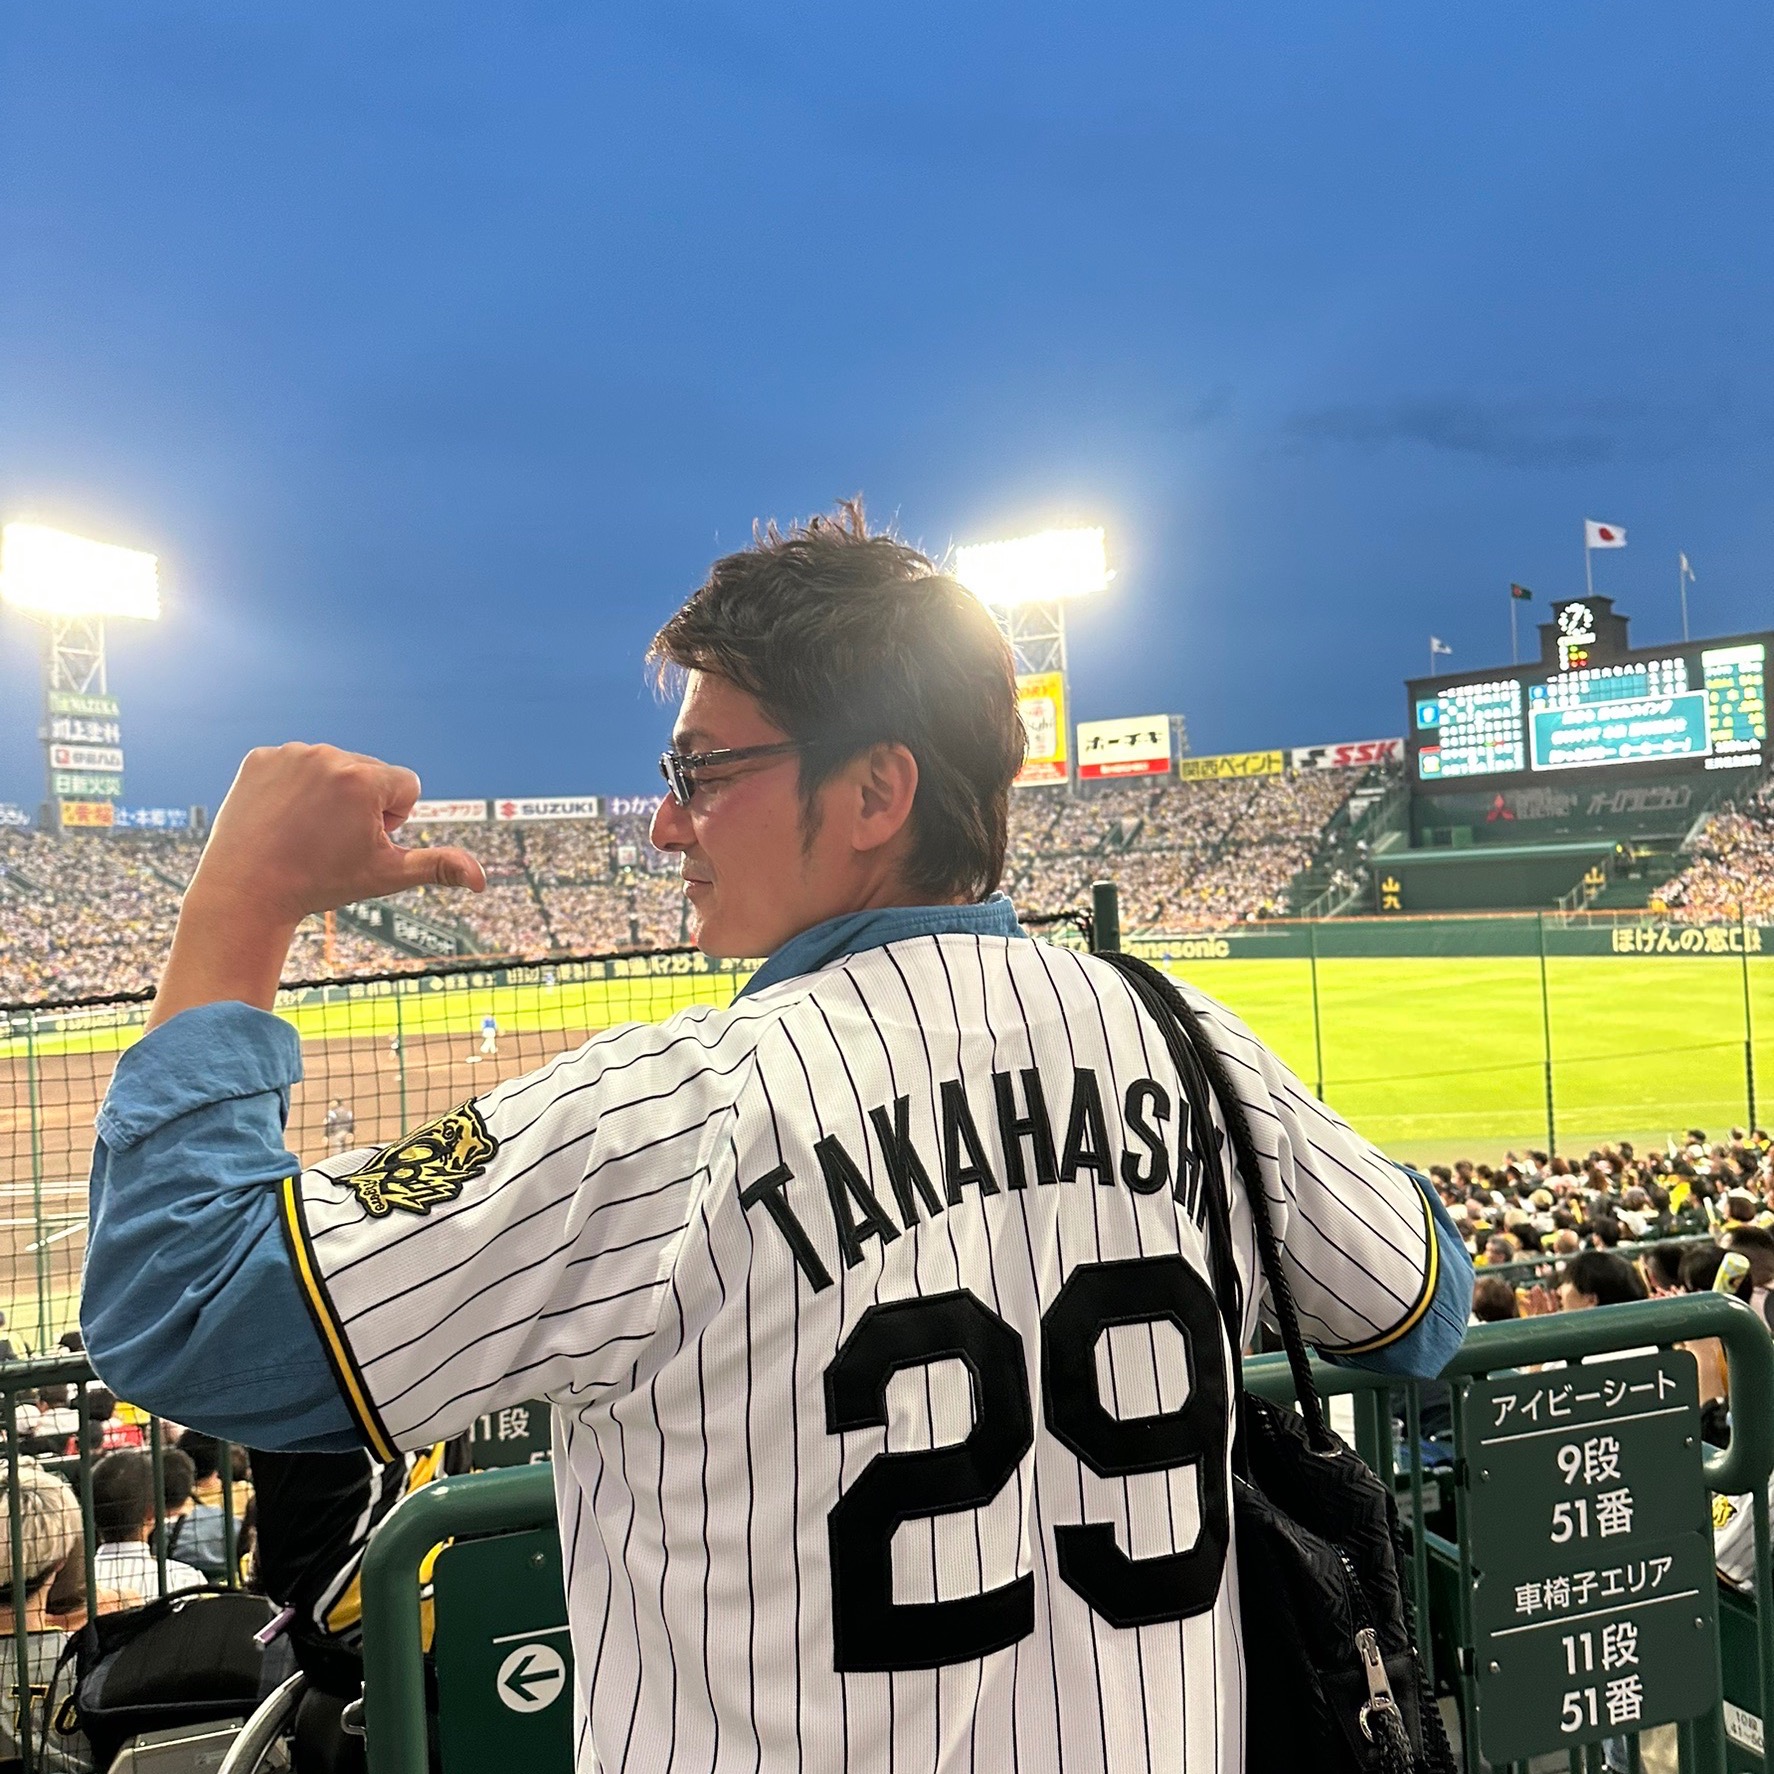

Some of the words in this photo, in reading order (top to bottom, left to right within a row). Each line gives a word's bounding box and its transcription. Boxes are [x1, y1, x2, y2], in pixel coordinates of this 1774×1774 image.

[1183, 753, 1281, 777] 関西ペイント
[1332, 741, 1398, 765] SSK
[522, 801, 593, 817] SUZUKI
[1492, 1370, 1677, 1427] アイビーシート
[823, 1253, 1230, 1672] 29
[1557, 1436, 1622, 1486] 9段
[1550, 1487, 1634, 1543] 51番
[1515, 1555, 1673, 1615] 車椅子エリア
[1561, 1621, 1639, 1675] 11段
[1561, 1674, 1644, 1733] 51番
